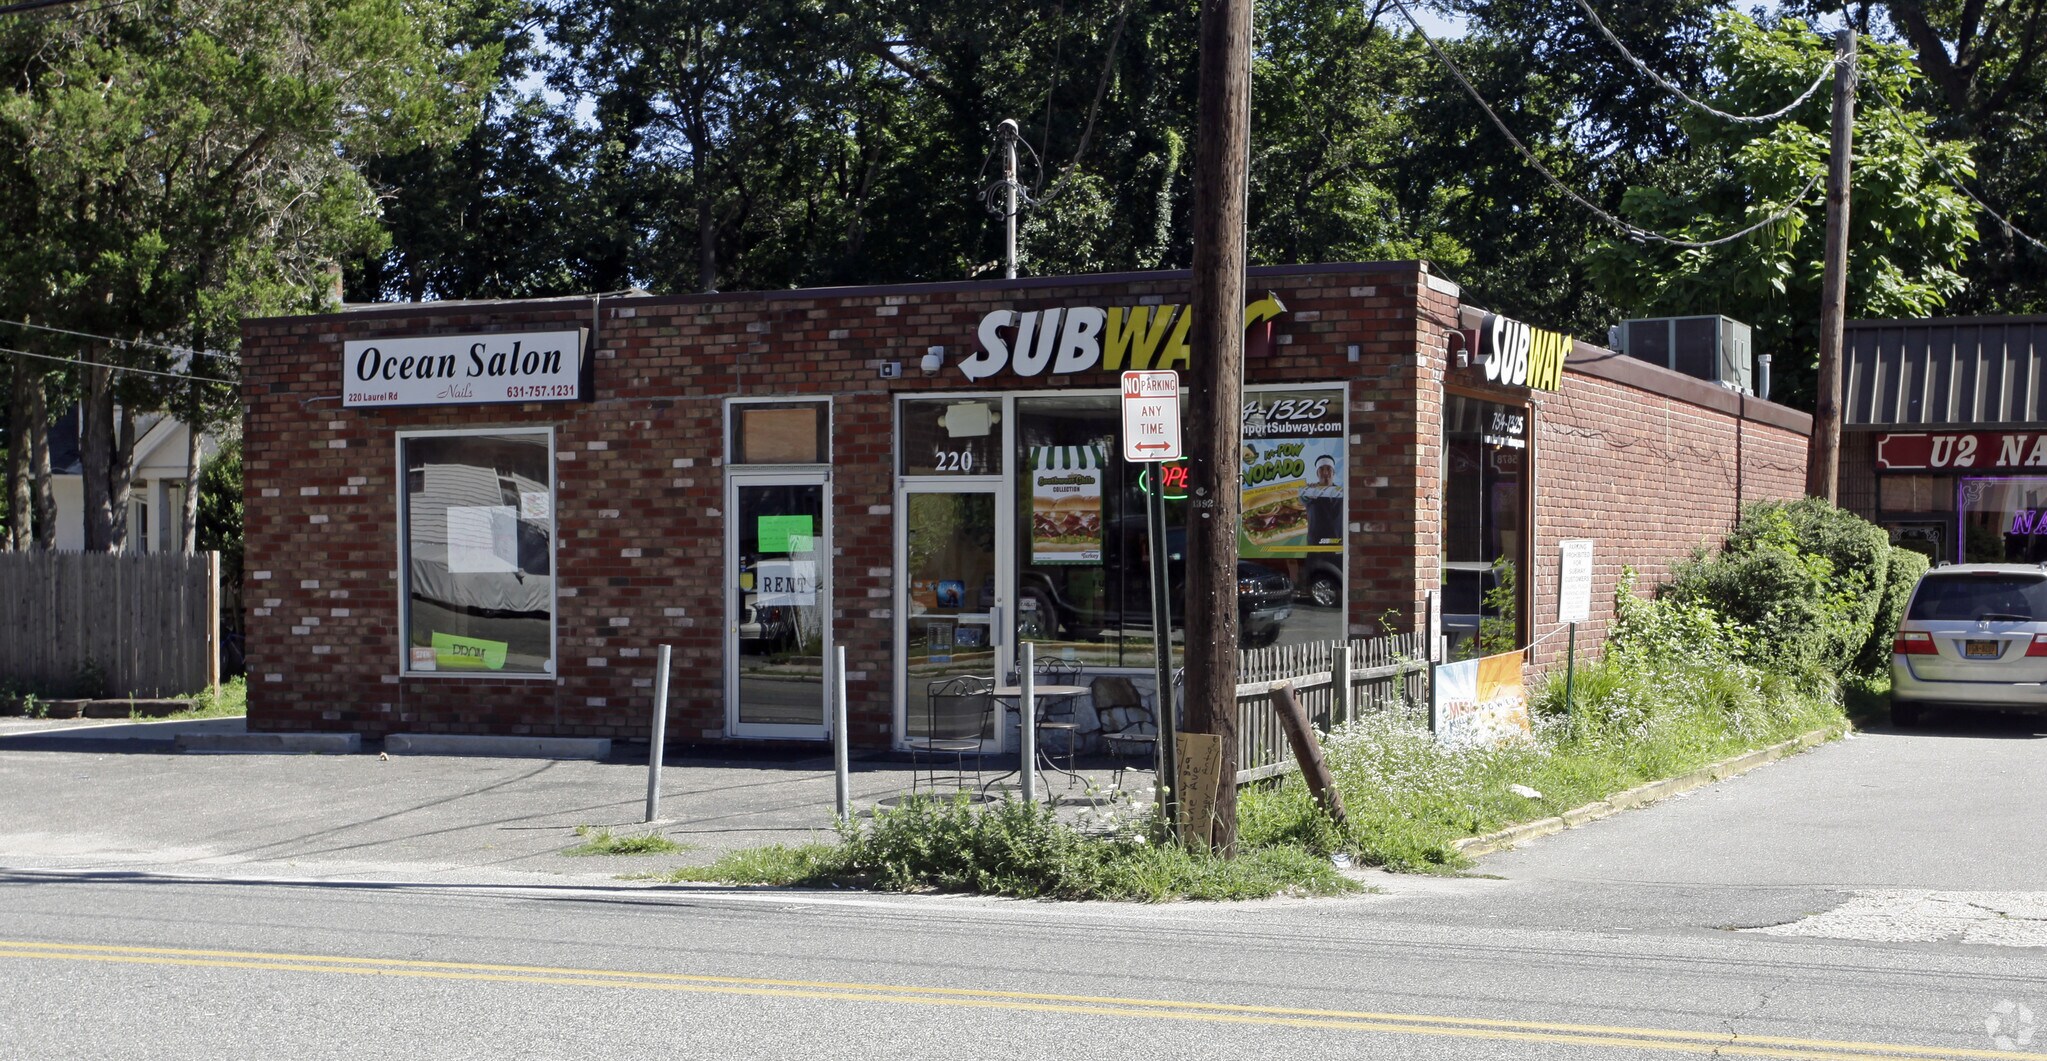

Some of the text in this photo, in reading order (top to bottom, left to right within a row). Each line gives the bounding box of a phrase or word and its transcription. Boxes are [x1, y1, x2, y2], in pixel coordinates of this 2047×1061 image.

[356, 341, 562, 381] Ocean Salon
[1484, 314, 1573, 392] SUBWAY
[436, 383, 473, 399] Nails
[506, 384, 574, 398] 631-757.1231
[1124, 377, 1175, 394] NO PARKING
[348, 391, 398, 402] 220 Laurel Rd
[1141, 405, 1162, 417] ANY
[1140, 423, 1164, 435] TIME
[1491, 412, 1524, 434] 754-1325
[1930, 434, 1978, 467] U2
[935, 451, 973, 471] 220
[1242, 457, 1306, 487] VOCADO
[763, 576, 806, 594] RENT
[1183, 766, 1201, 832] June Ave
